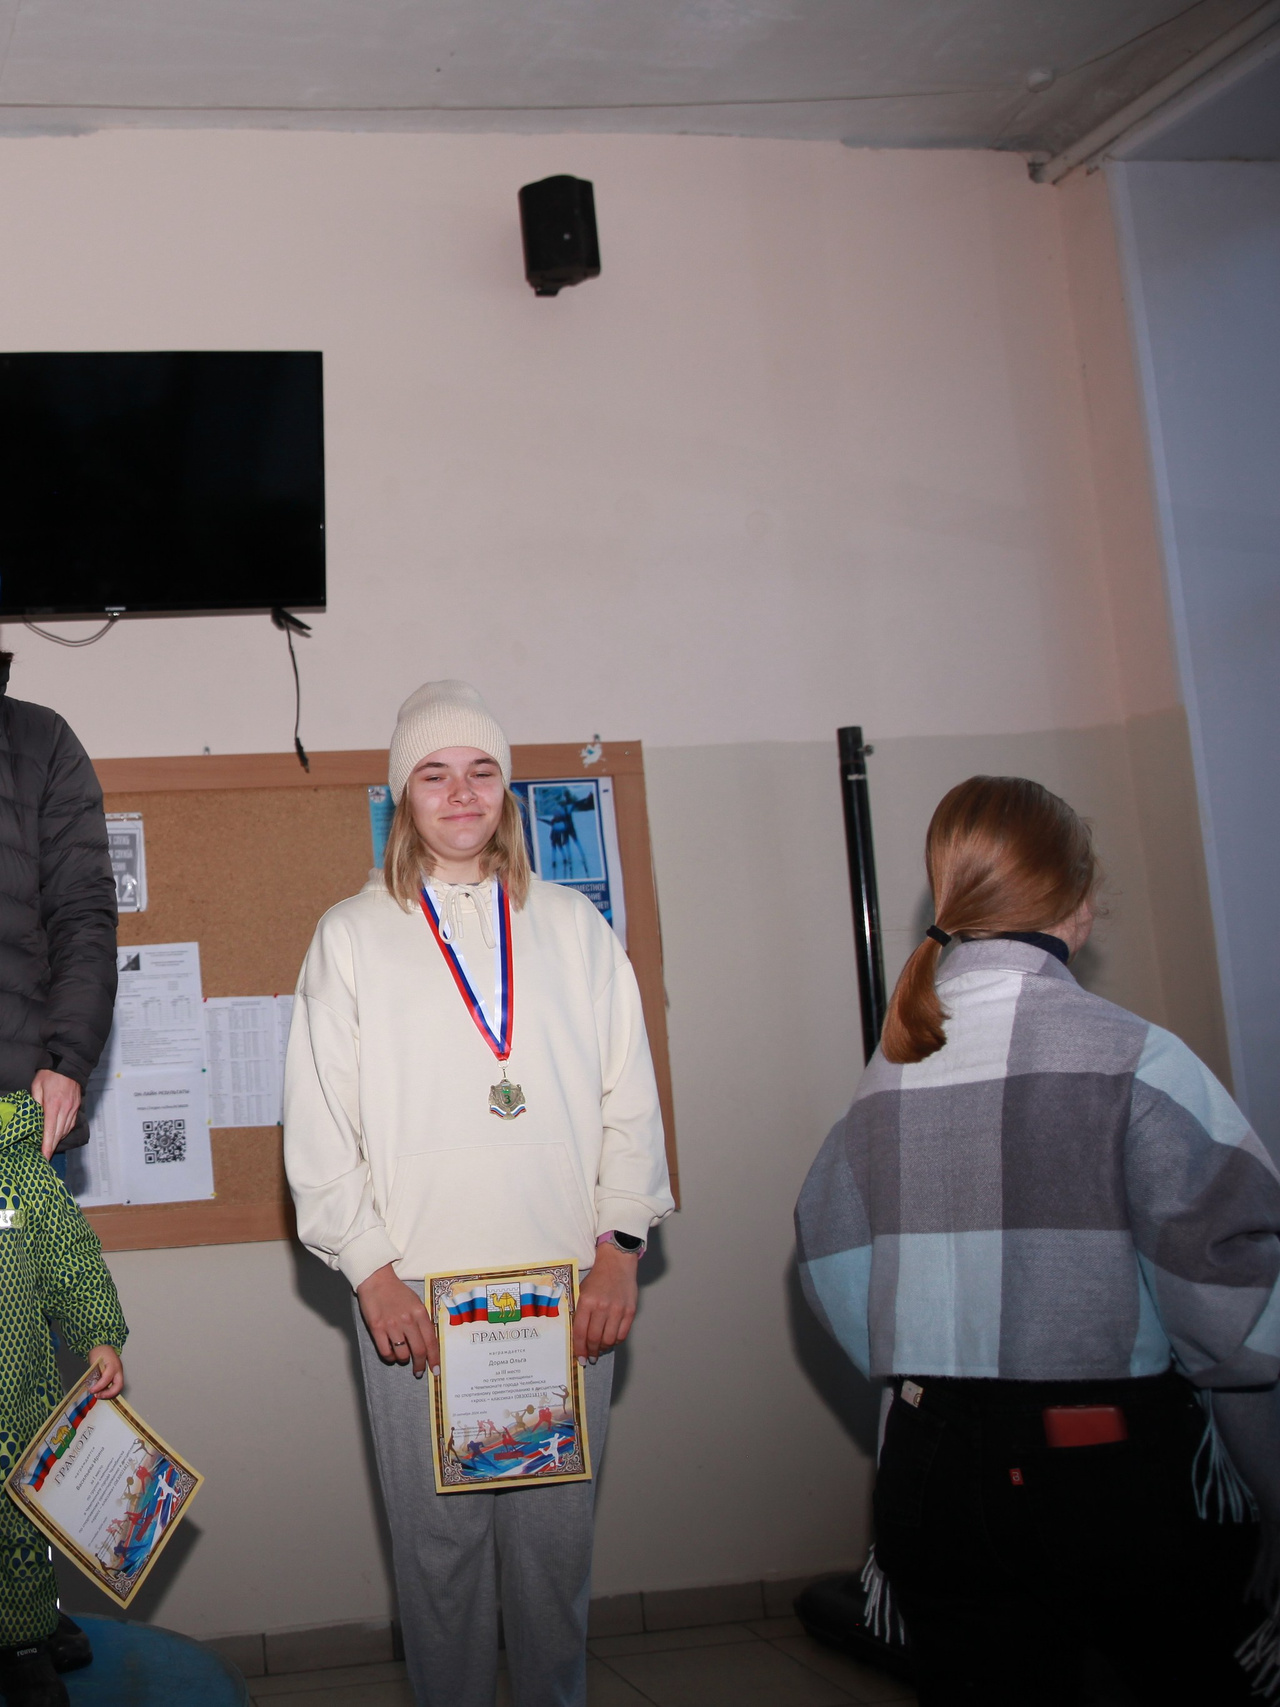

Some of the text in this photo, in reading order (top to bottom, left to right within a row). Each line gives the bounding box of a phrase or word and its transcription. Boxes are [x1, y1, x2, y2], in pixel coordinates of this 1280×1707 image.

[504, 1095, 511, 1104] 3
[472, 1328, 539, 1342] ГРАМОТА
[54, 1424, 94, 1484] ГРАМОТА
[74, 1446, 95, 1478] награждается
[76, 1446, 104, 1490] Васильева Ирина
[17, 1646, 37, 1657] reima
